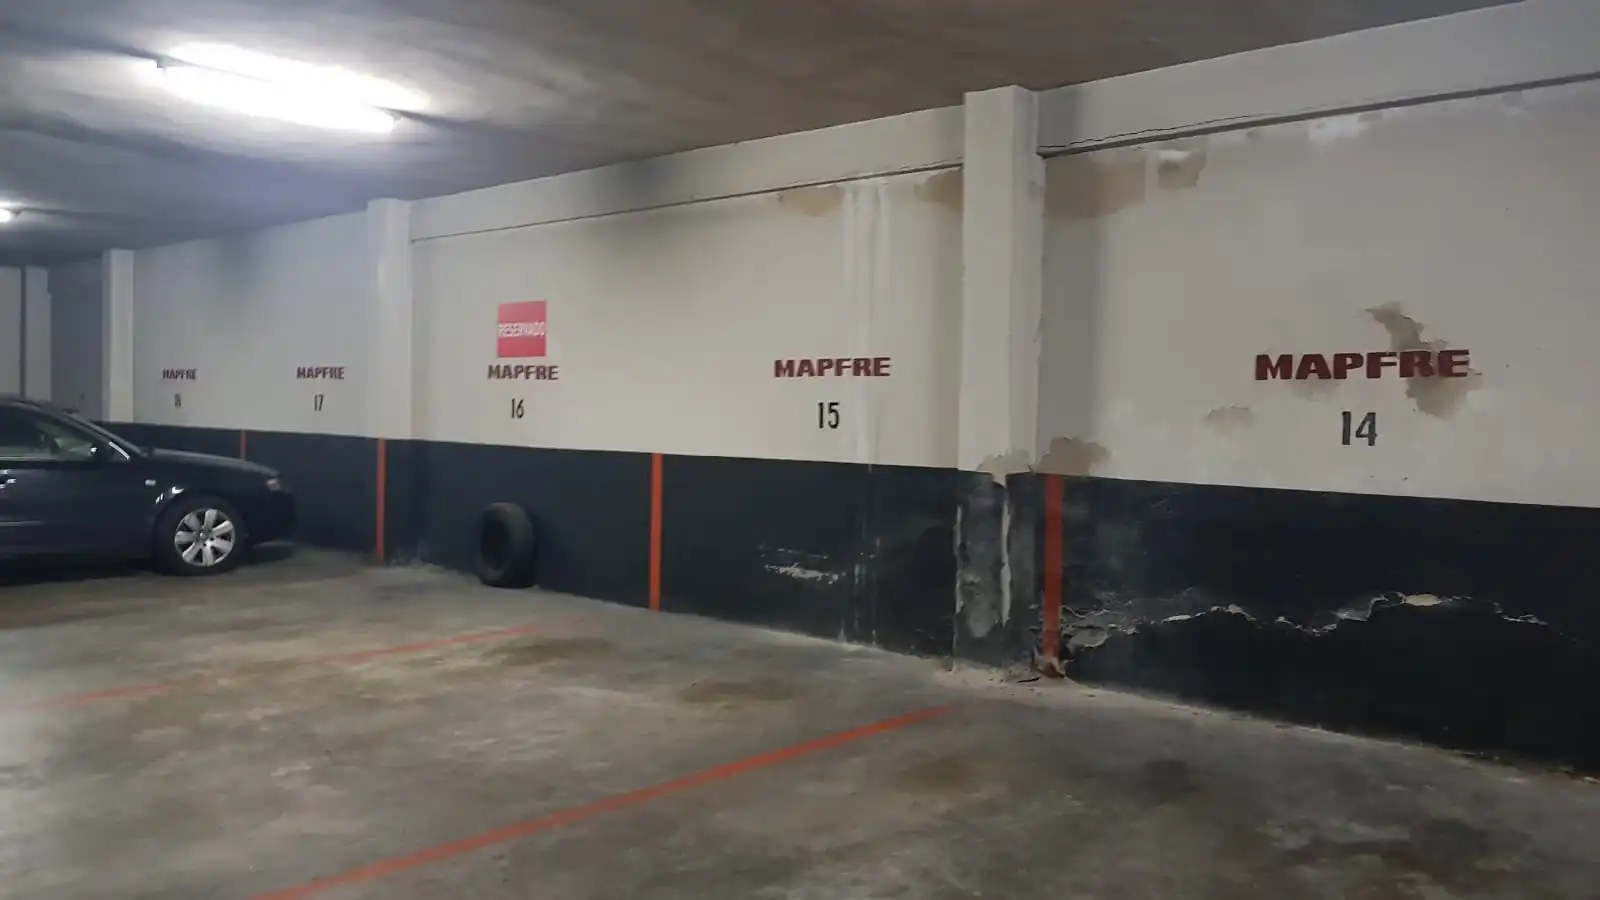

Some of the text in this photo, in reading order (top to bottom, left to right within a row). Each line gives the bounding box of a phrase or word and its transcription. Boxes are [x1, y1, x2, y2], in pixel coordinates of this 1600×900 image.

[297, 366, 345, 380] MAPFRE
[487, 365, 559, 380] MAPFRE
[774, 357, 891, 377] MAPFRE
[1255, 350, 1470, 380] MAPFRE
[314, 394, 324, 411] 17
[511, 398, 525, 419] 16
[818, 402, 840, 429] 15
[1341, 411, 1377, 447] 14
